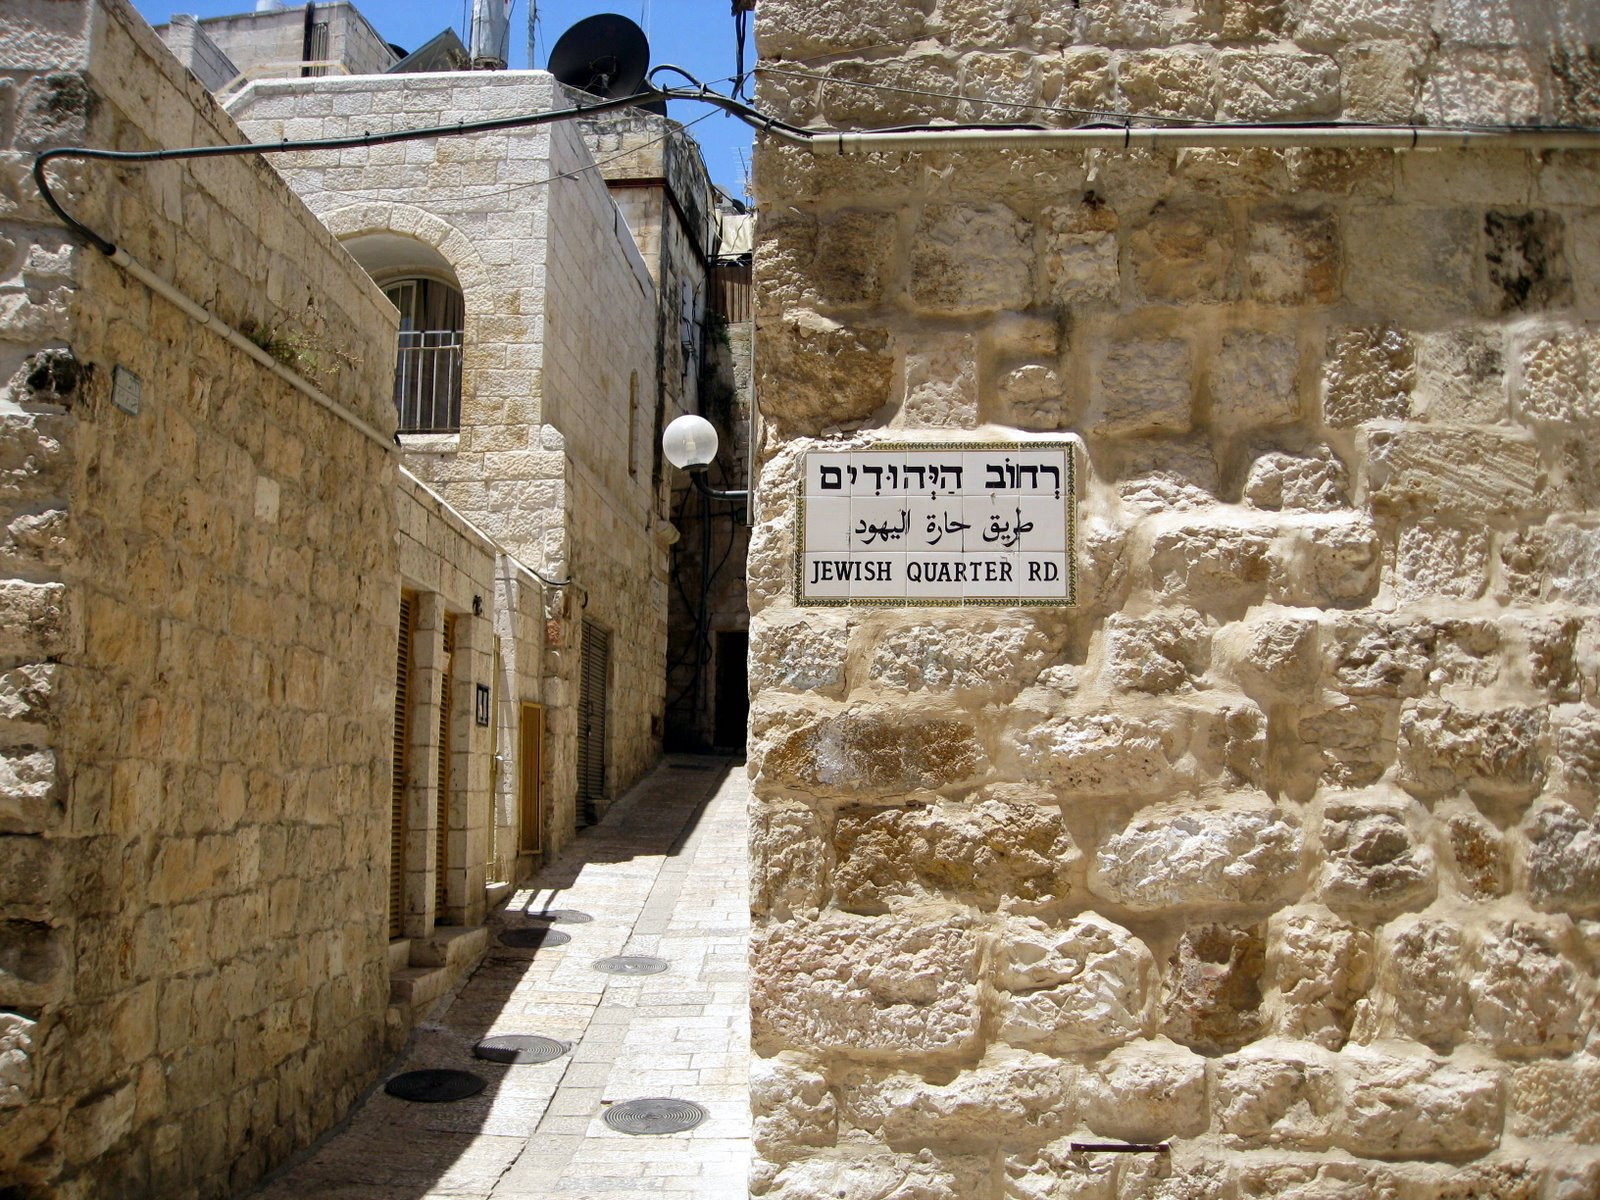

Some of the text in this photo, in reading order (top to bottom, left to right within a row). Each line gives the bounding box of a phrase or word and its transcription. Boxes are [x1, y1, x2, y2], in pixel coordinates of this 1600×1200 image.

[854, 506, 1034, 547] طريق حارة اليهود
[810, 560, 1060, 584] JEWISH QUARTER RD.
